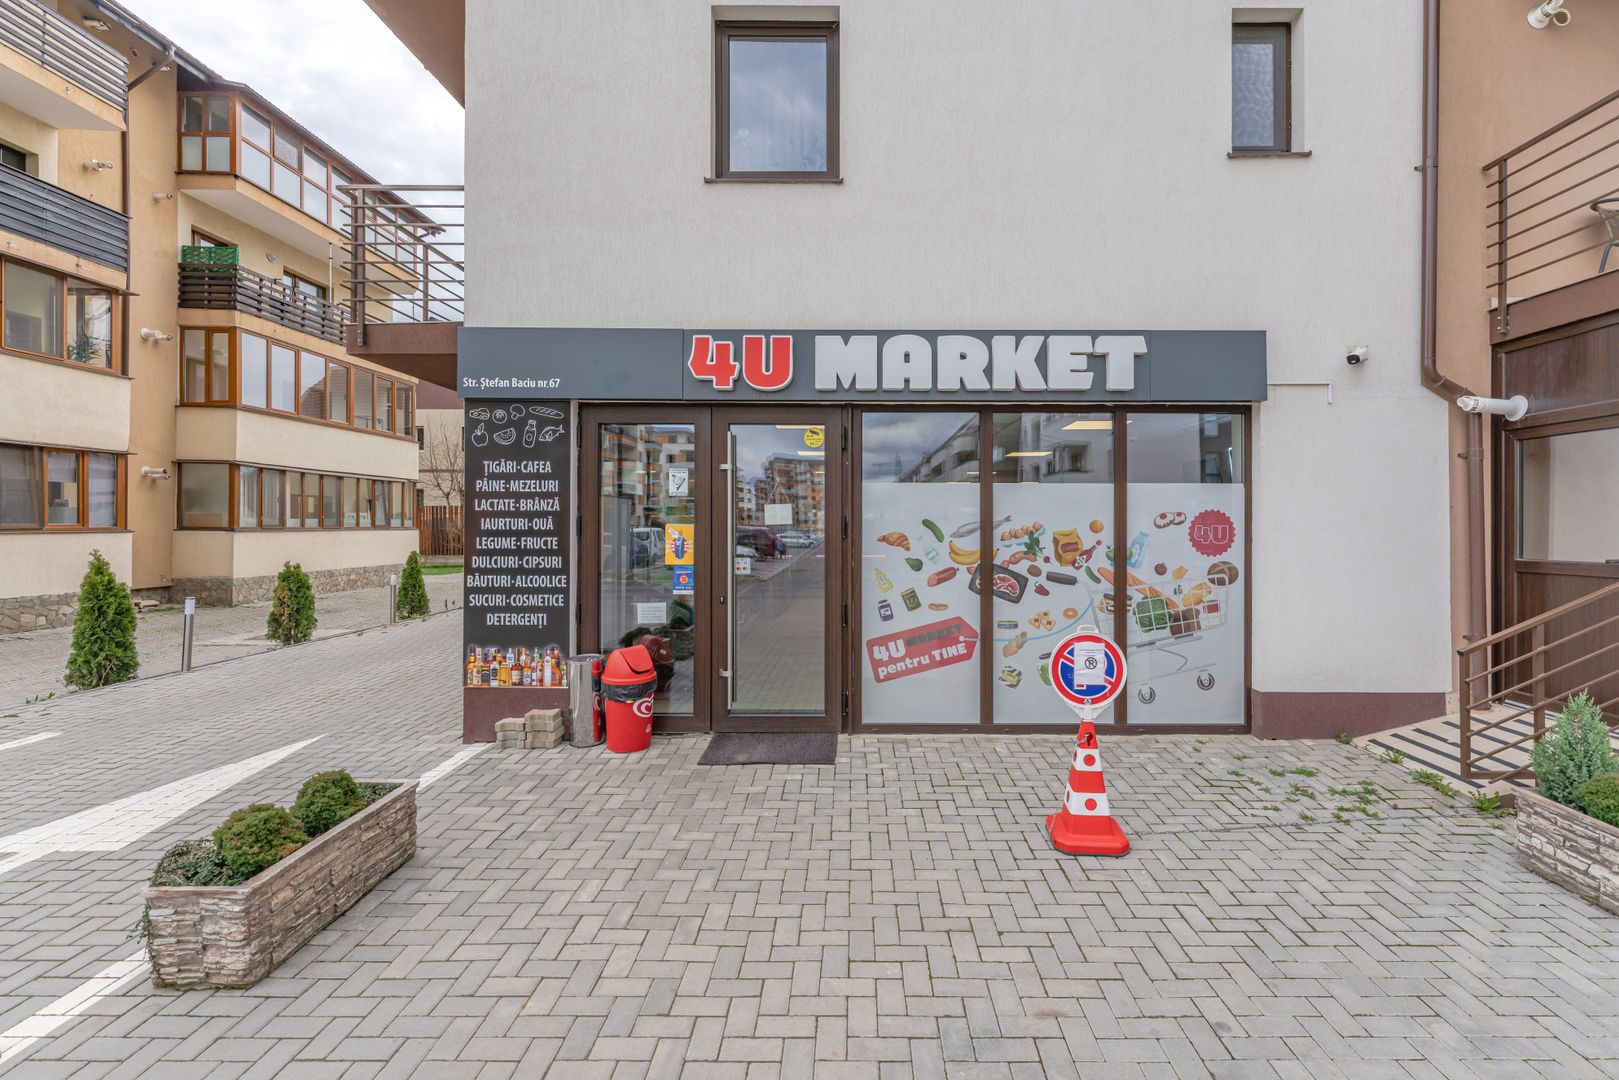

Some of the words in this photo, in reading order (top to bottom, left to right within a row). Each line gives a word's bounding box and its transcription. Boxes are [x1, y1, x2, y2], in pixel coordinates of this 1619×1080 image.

[687, 334, 795, 392] 4U
[814, 334, 1149, 392] MARKET
[462, 377, 479, 387] Str.
[480, 377, 510, 390] Ștefan
[511, 377, 536, 388] Baciu
[1194, 524, 1229, 544] 4U
[486, 613, 547, 629] DETERGENȚI
[872, 639, 906, 661] 4U
[906, 623, 961, 647] MARKET
[878, 654, 931, 679] pentru
[931, 643, 968, 661] TINE
